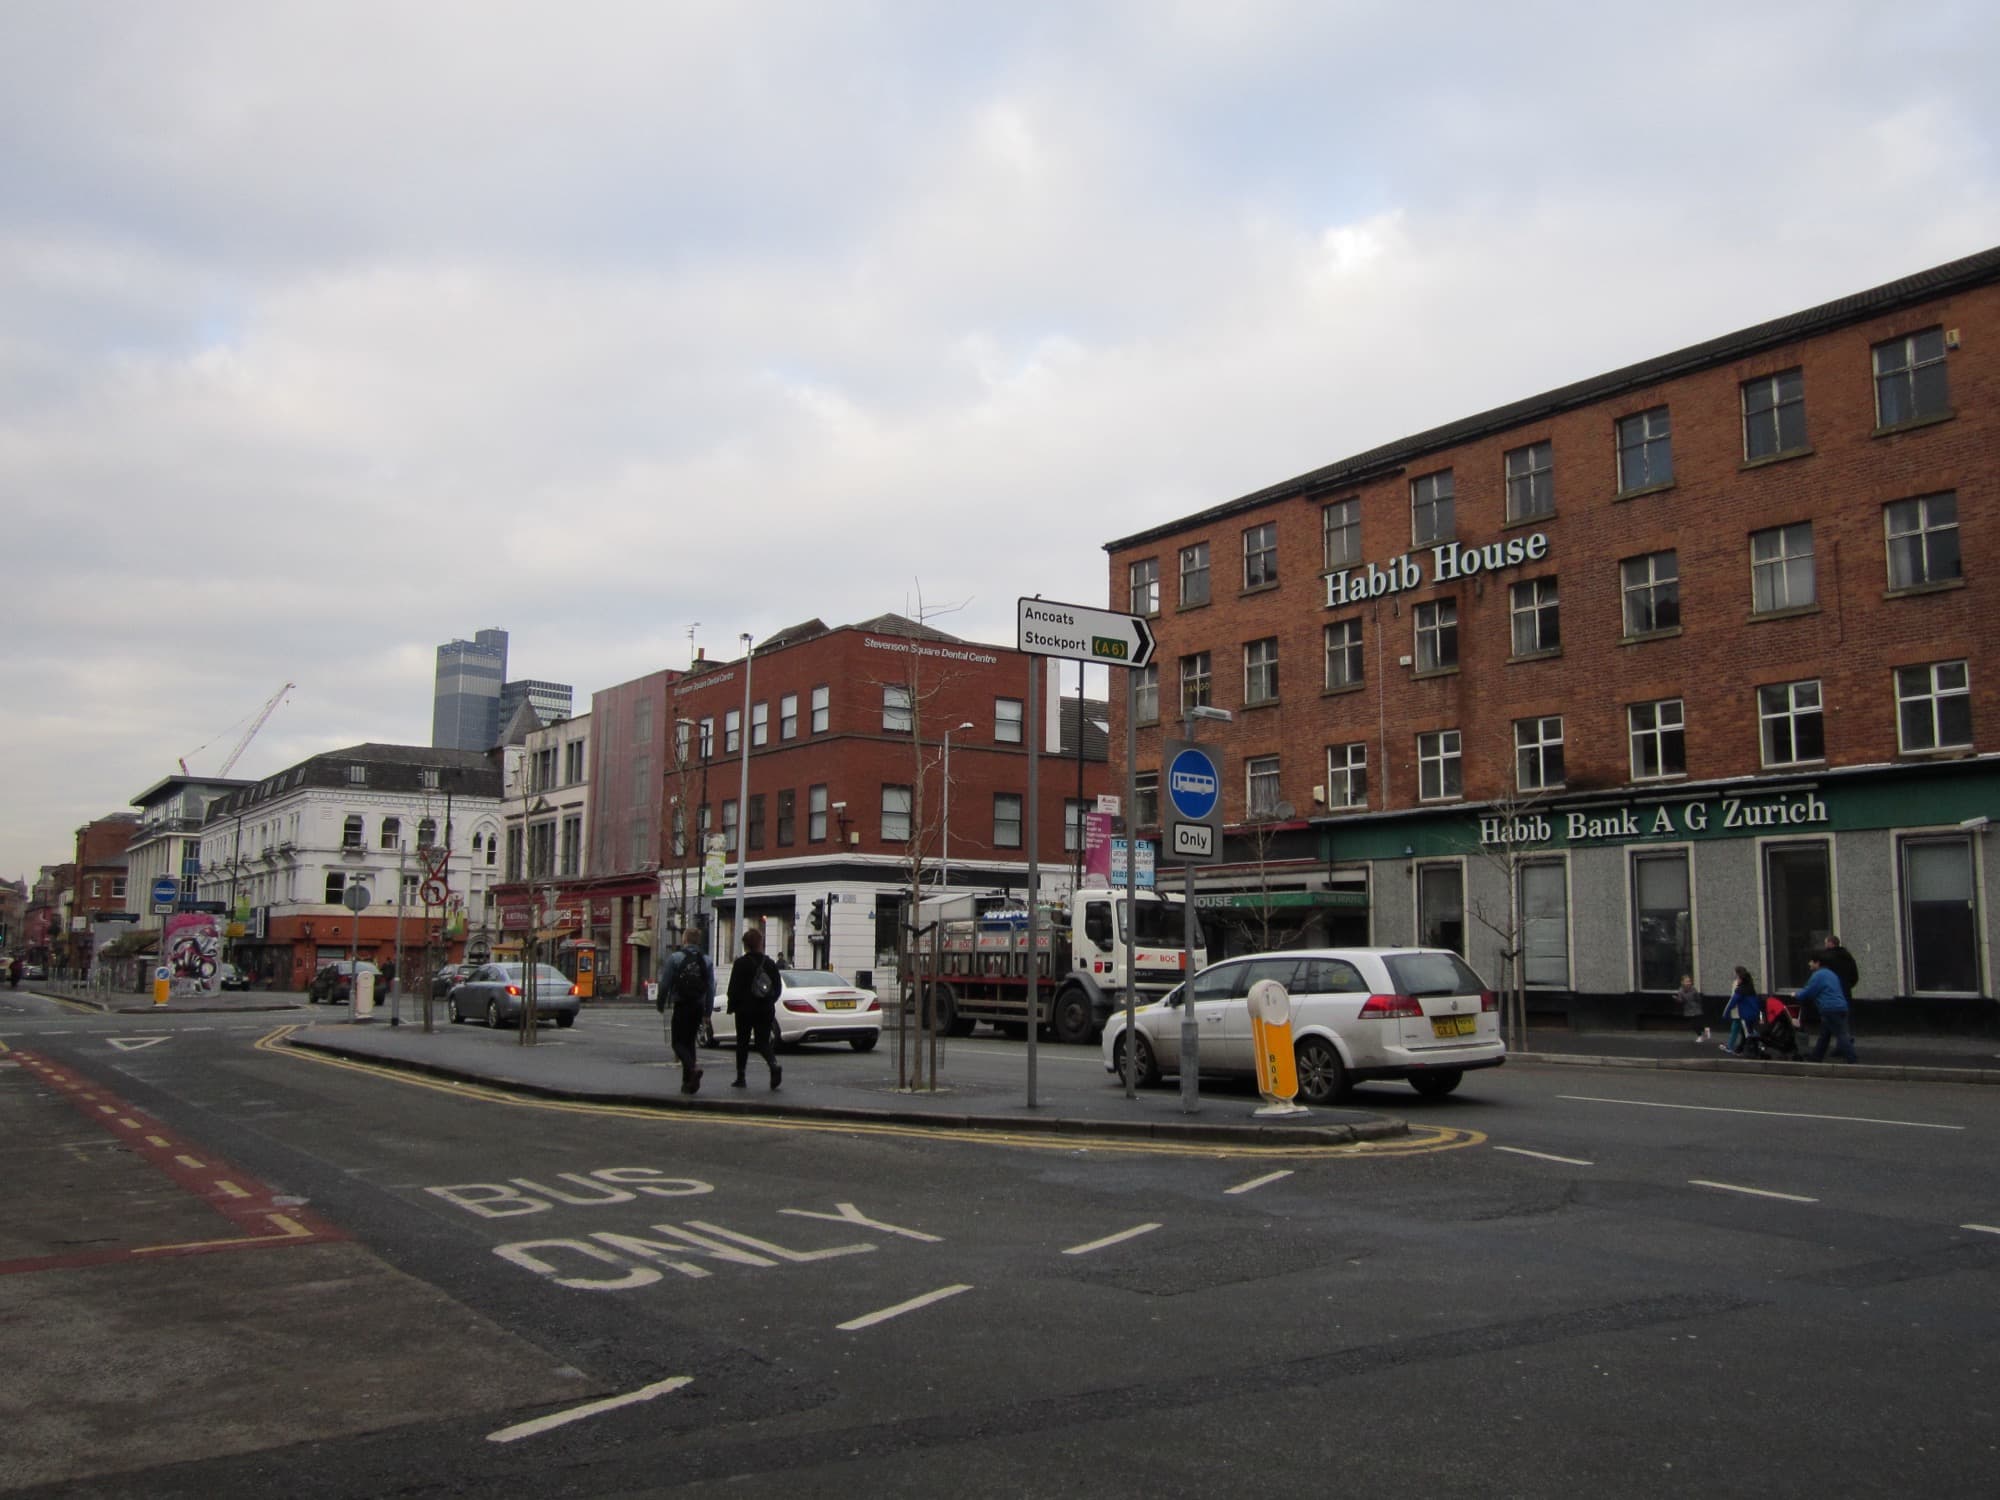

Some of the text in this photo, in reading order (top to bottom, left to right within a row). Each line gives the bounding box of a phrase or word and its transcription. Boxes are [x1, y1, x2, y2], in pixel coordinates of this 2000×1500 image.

[1324, 532, 1547, 608] Habib House
[1025, 607, 1074, 625] Ancoats
[864, 637, 997, 664] Stevenson Square Dental Centre
[1025, 631, 1086, 650] Stockport
[1479, 794, 1829, 845] Habib Bank A G Zurich
[1180, 831, 1207, 849] Only
[1159, 954, 1177, 963] BOC
[424, 1167, 715, 1218] BUS
[492, 1203, 945, 1290] ONLY
